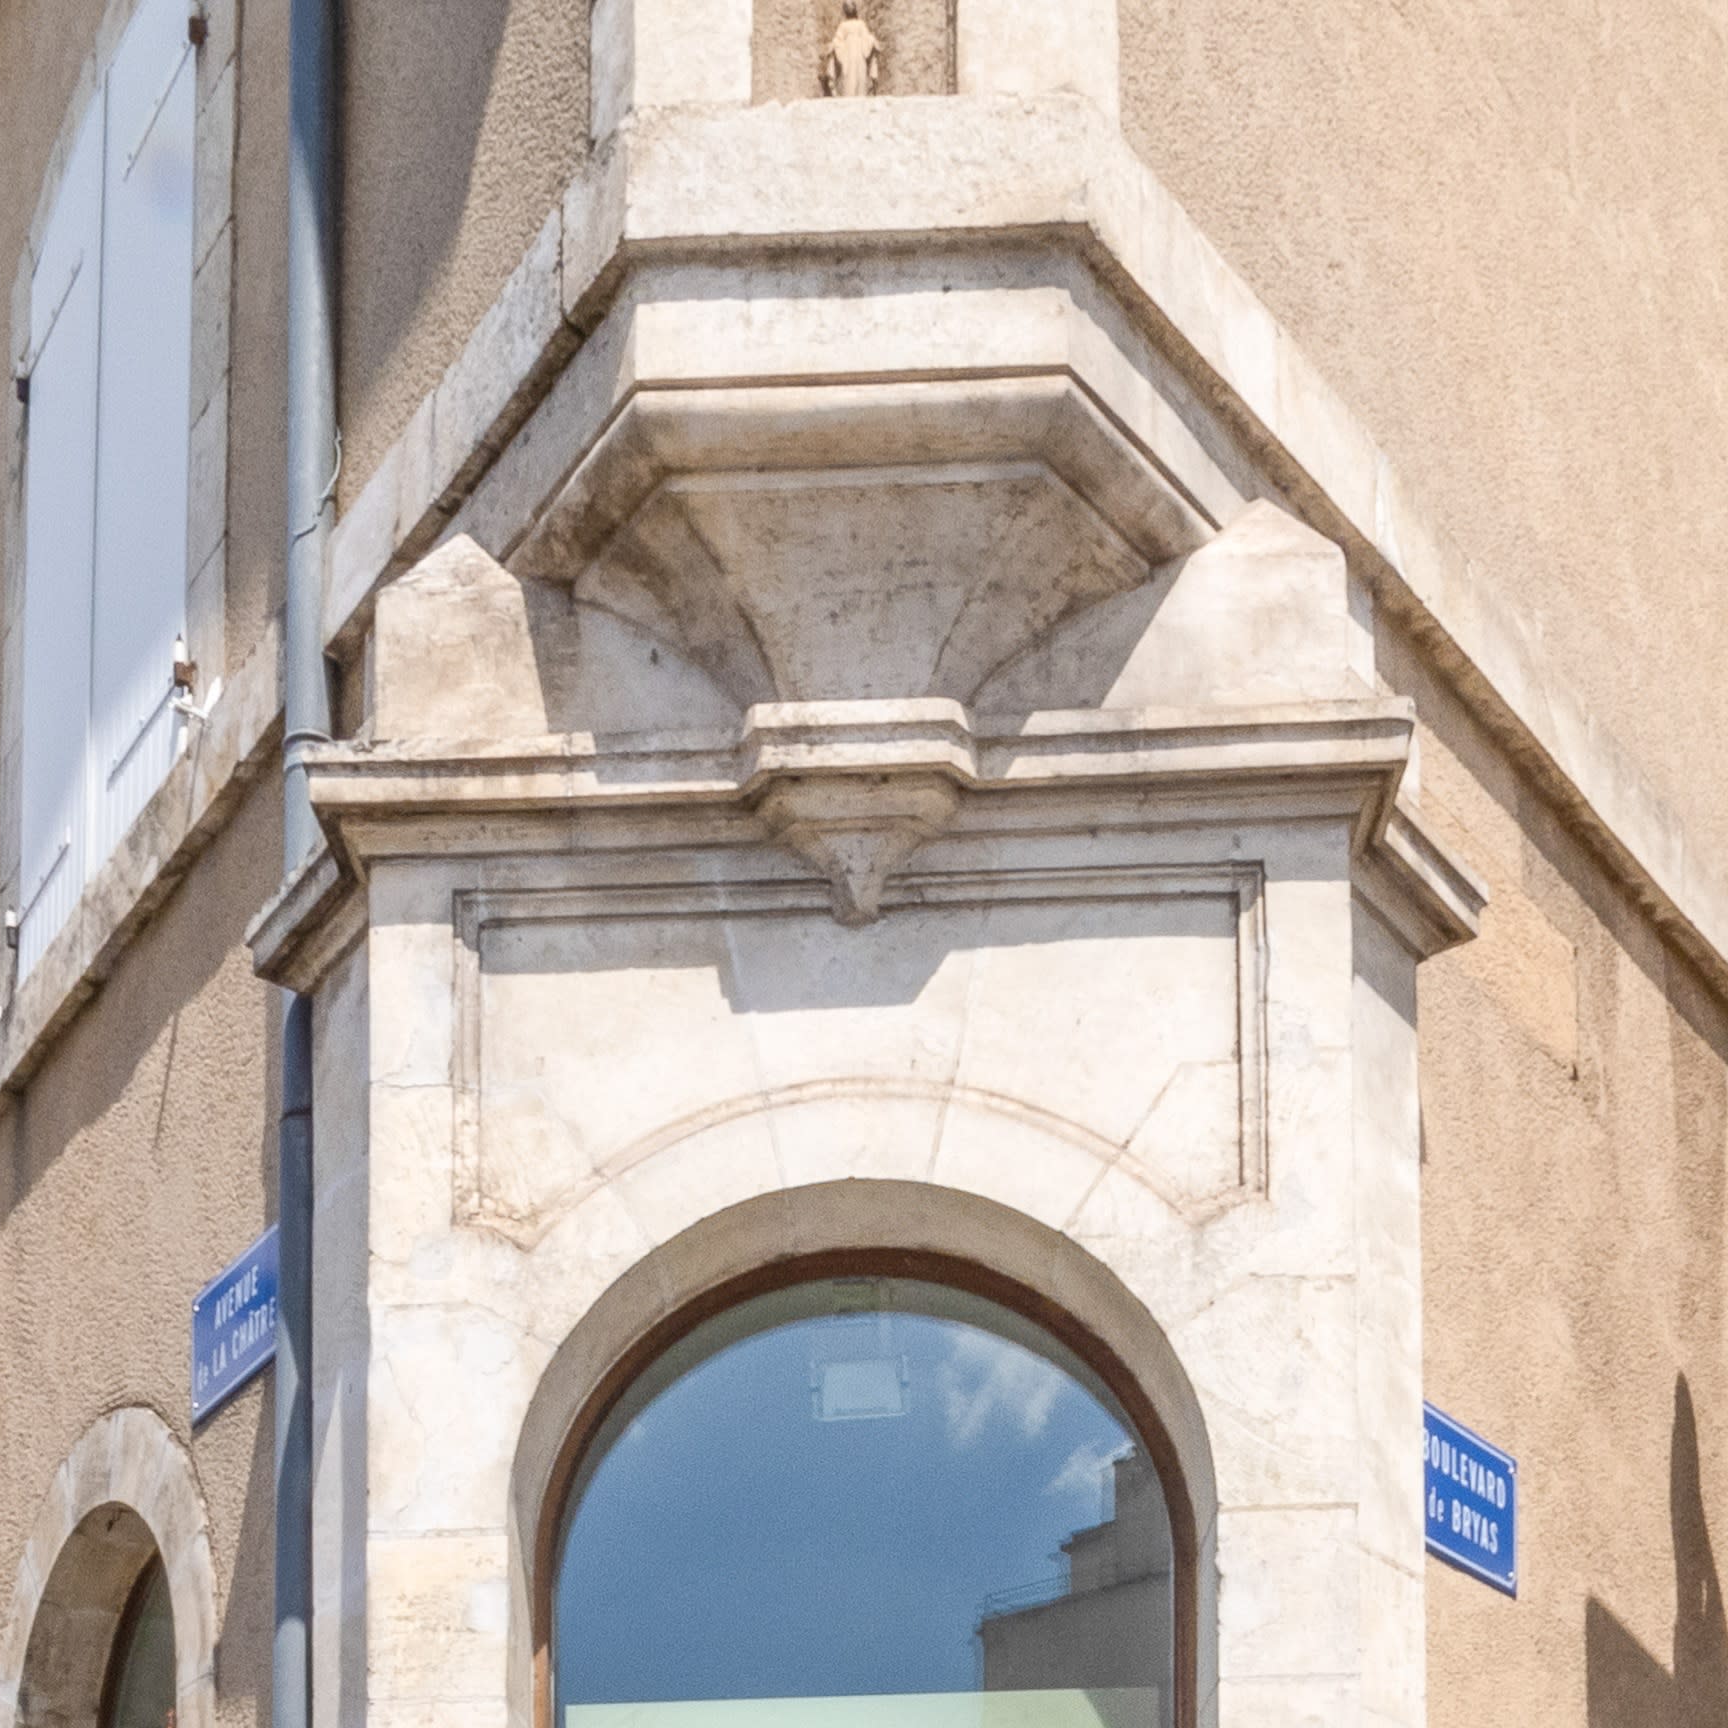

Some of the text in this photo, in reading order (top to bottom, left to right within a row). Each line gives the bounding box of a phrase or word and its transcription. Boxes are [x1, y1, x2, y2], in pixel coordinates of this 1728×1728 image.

[214, 1264, 259, 1330] AVENUE
[212, 1341, 227, 1376] LA
[1422, 1428, 1507, 1510] BOULEVARD
[1428, 1486, 1499, 1555] de BRYAS
